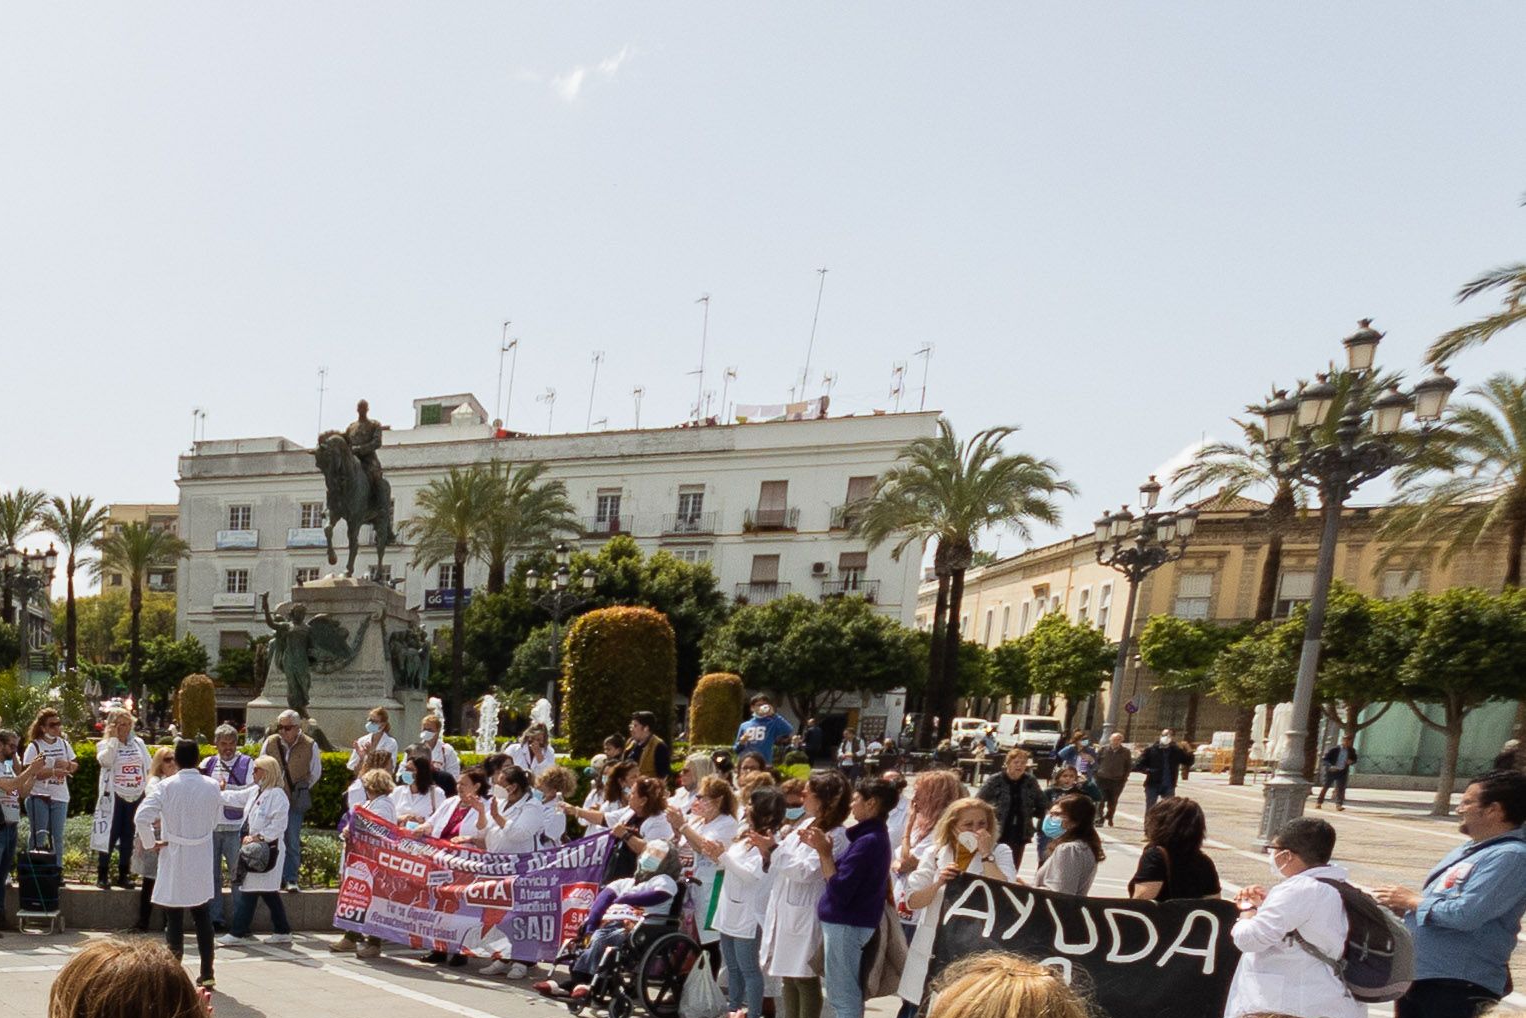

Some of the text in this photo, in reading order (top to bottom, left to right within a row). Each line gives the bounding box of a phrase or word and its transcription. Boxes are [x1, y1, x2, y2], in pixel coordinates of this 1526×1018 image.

[378, 851, 427, 878] CCOO
[347, 879, 367, 893] SAD
[336, 902, 366, 922] CGT
[513, 915, 555, 942] SAD
[942, 878, 1220, 976] AYUDA
